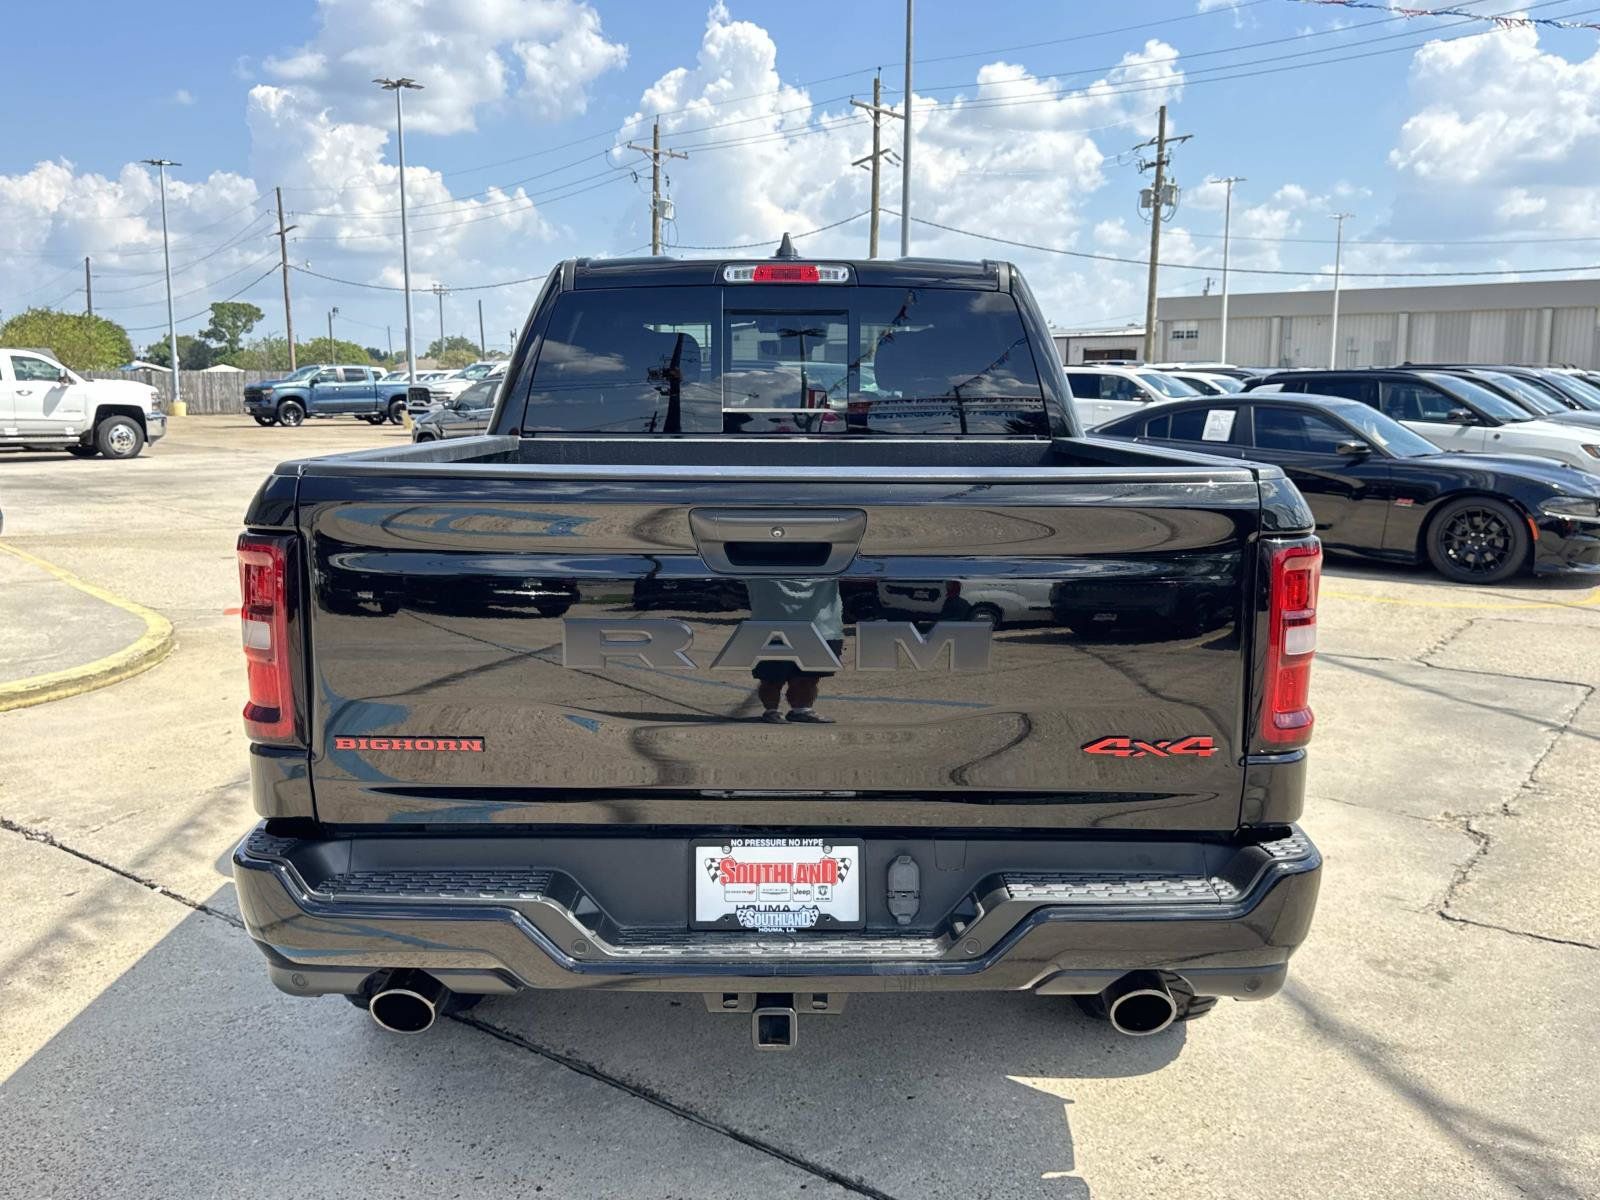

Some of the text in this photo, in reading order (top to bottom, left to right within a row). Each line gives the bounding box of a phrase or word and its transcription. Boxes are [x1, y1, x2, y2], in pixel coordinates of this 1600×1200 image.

[563, 618, 992, 670] RAM
[335, 737, 483, 751] BIGHORN
[720, 858, 838, 885] SOUTHLAND
[794, 888, 811, 896] Jeep
[745, 910, 811, 927] SOUTHLAND
